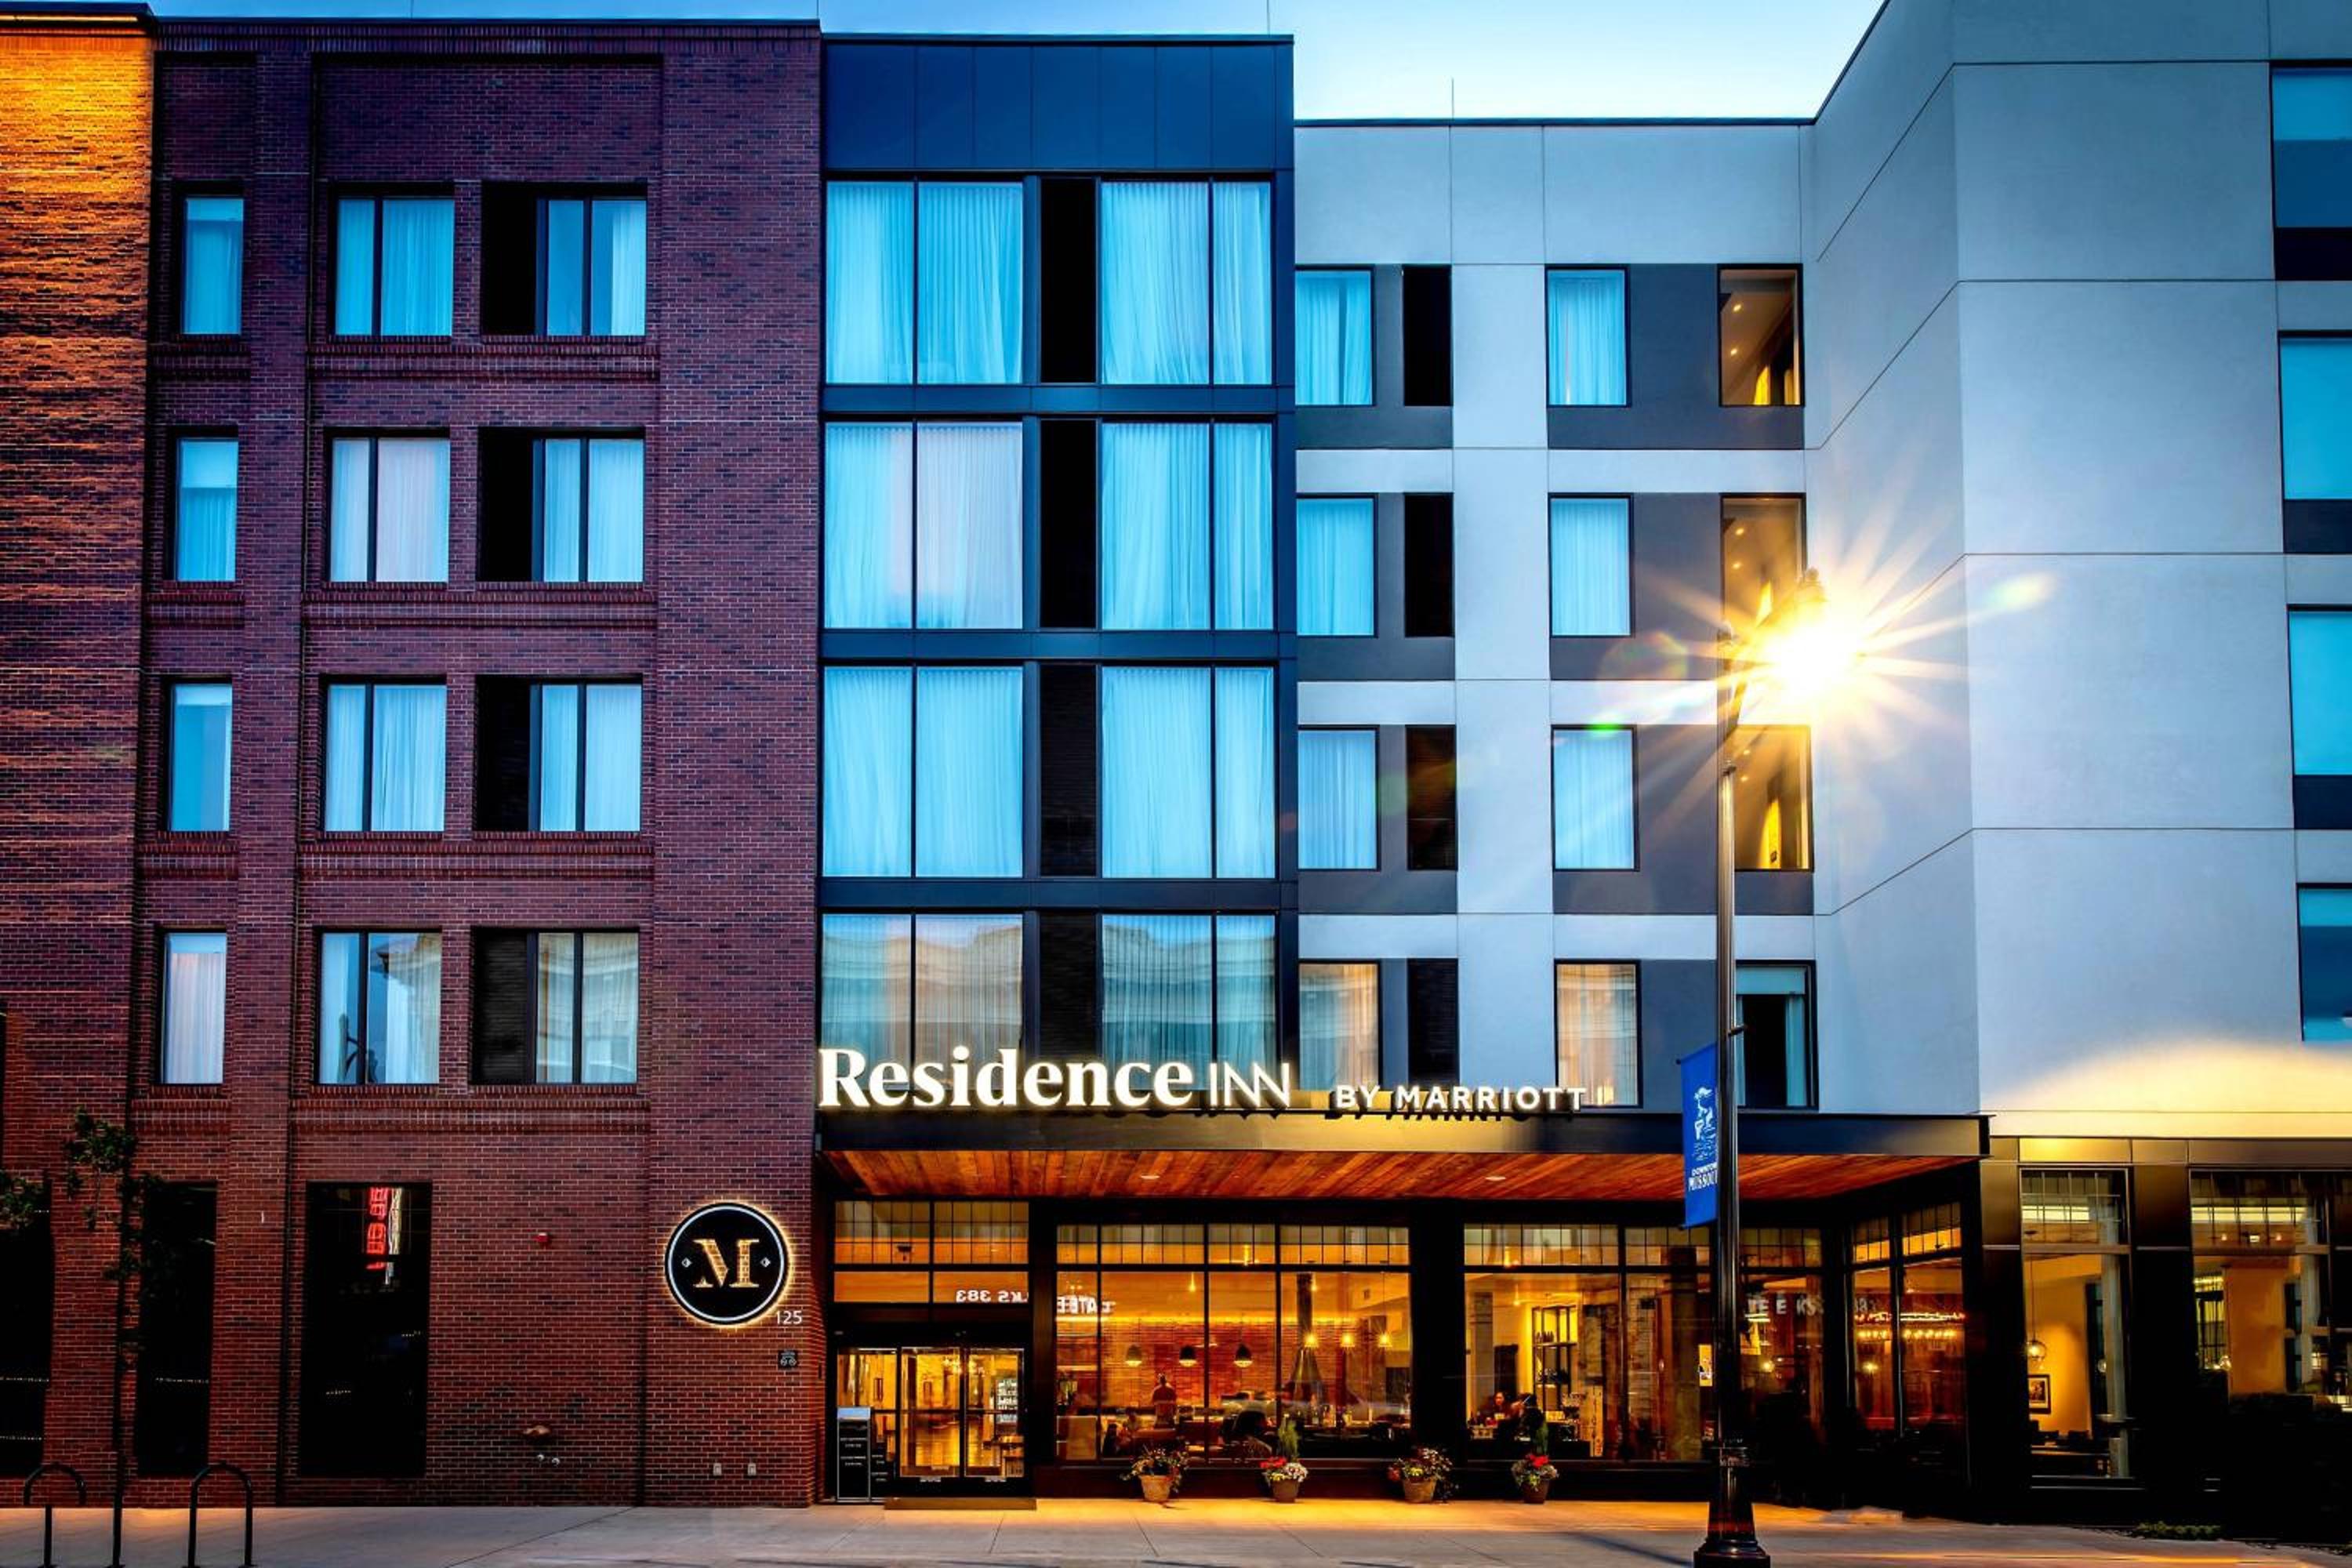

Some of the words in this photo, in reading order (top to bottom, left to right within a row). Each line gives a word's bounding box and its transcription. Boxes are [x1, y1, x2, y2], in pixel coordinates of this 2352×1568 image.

[818, 1045, 1192, 1109] Residence
[1209, 1062, 1290, 1109] INN
[1335, 1085, 1381, 1109] BY
[1395, 1085, 1587, 1111] MARRIOTT
[693, 1239, 760, 1288] M
[776, 1310, 802, 1324] 125
